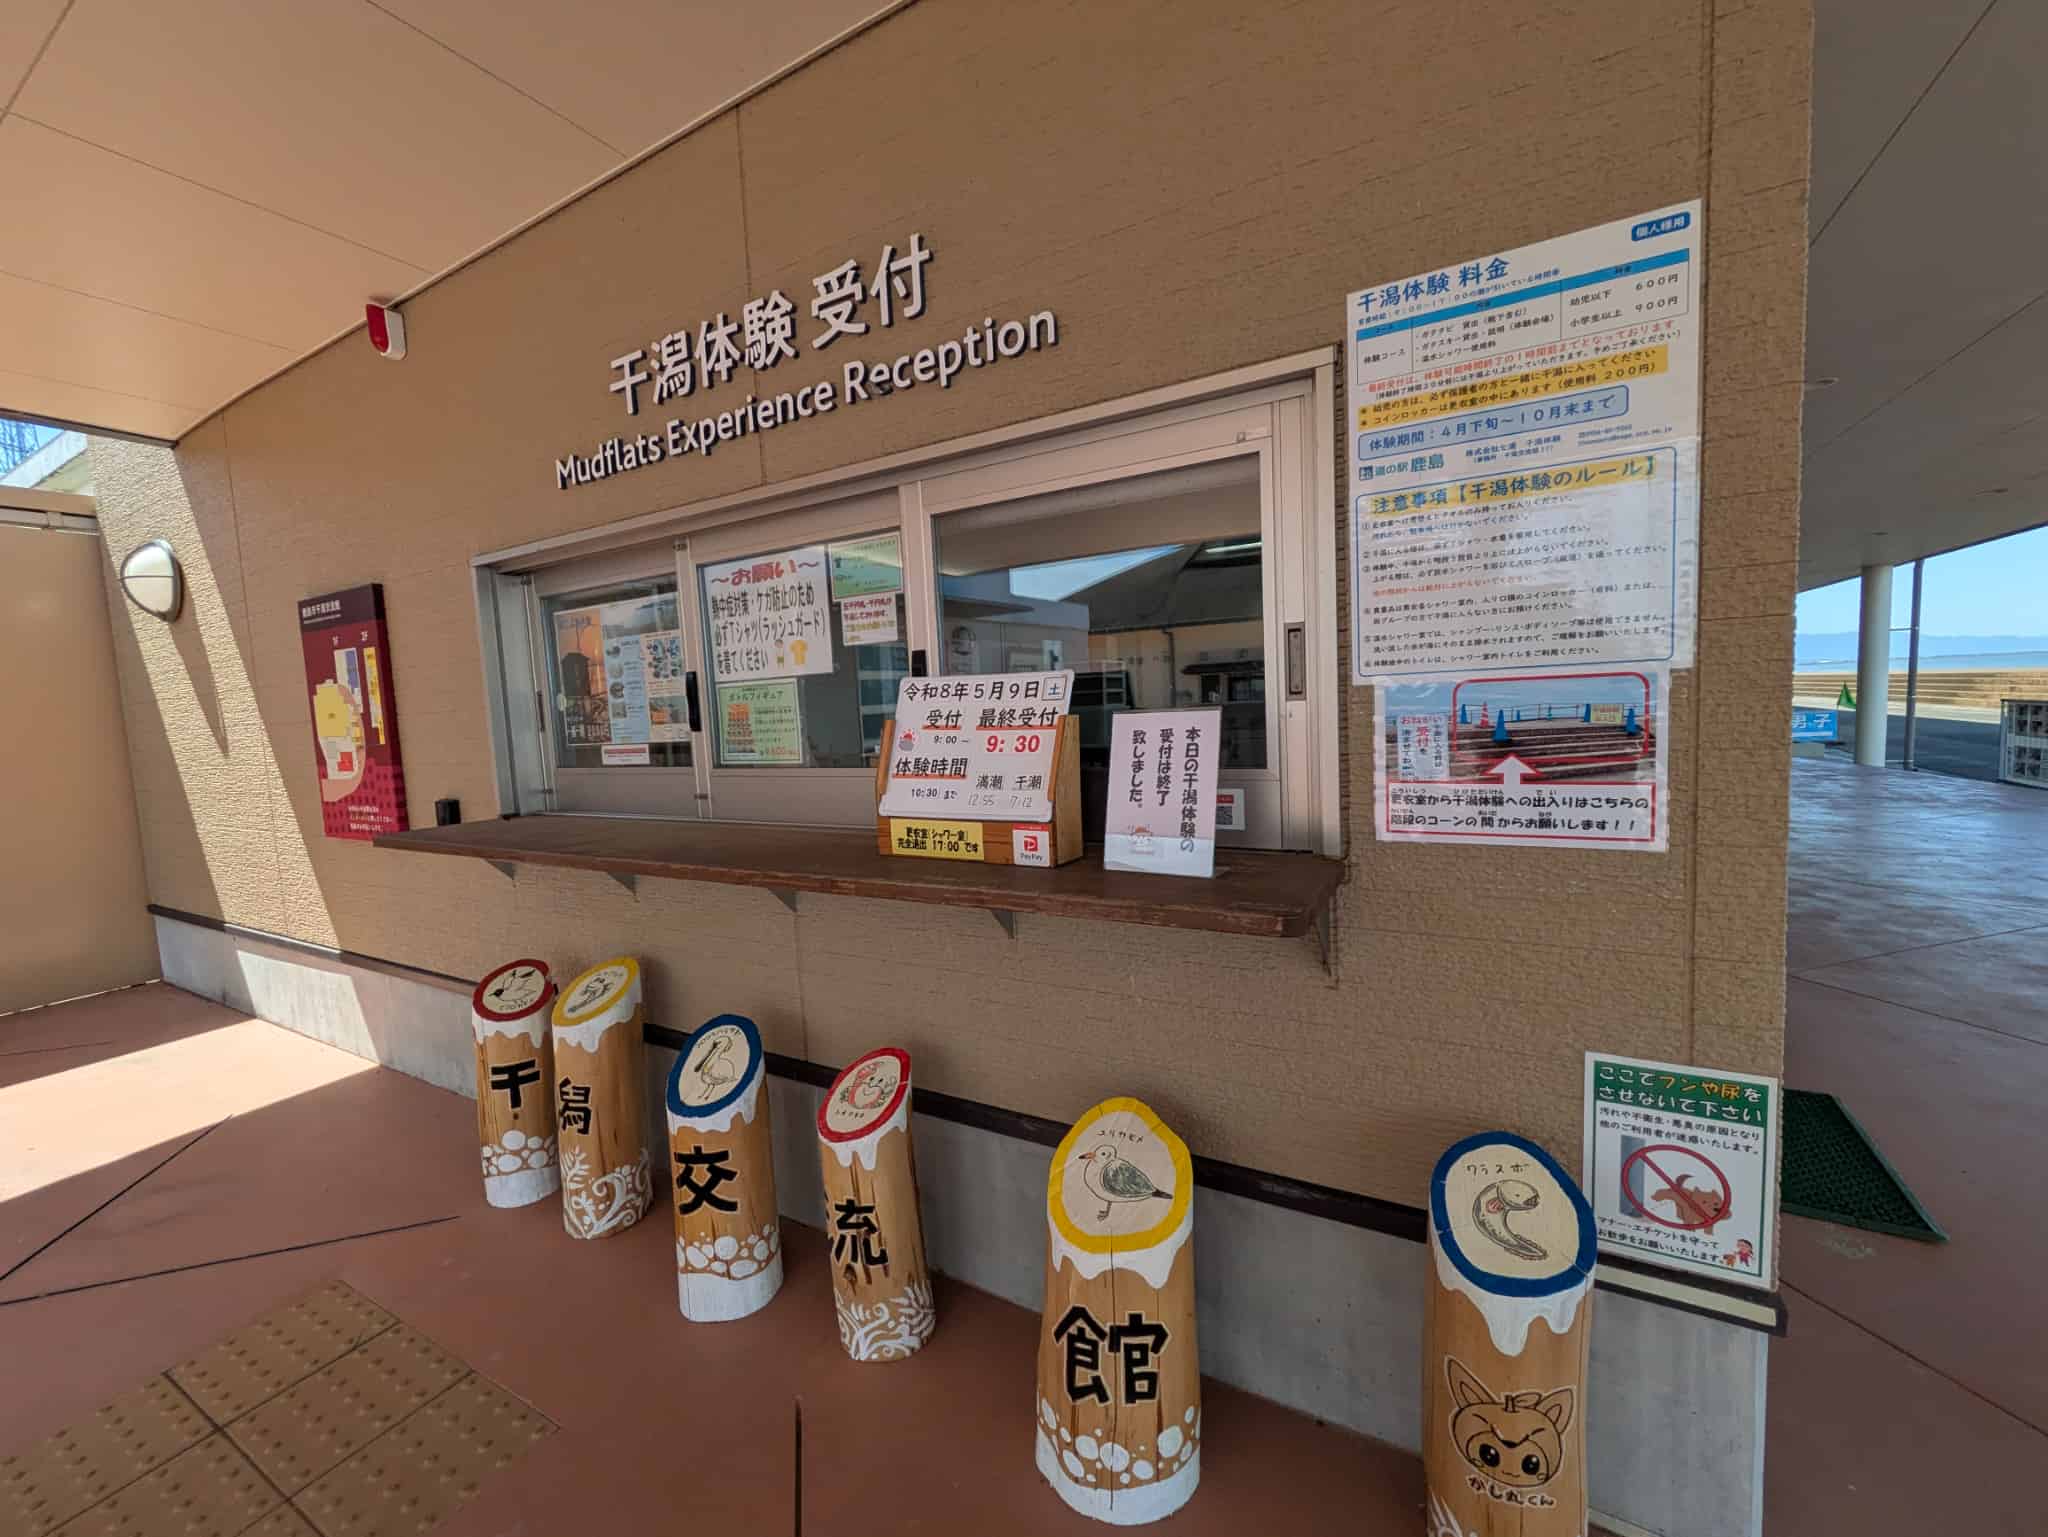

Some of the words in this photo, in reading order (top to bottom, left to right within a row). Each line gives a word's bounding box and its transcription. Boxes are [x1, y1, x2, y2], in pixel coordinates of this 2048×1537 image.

[1636, 215, 1685, 238] 個人様用
[1357, 272, 1451, 313] 干潟体験
[1458, 257, 1510, 287] 料金
[1635, 274, 1678, 290] 600円
[1635, 296, 1678, 312] 900円
[609, 289, 796, 414] 干潟体験
[810, 233, 930, 349] 受付
[555, 431, 662, 489] Mudflats
[667, 380, 833, 456] Experience
[844, 310, 1057, 403] Reception
[904, 680, 1040, 702] 令和8年5月9日
[1047, 682, 1061, 696] 土
[926, 709, 962, 729] 受付
[979, 706, 1058, 728] 最終受付
[986, 734, 1041, 753] 9:30
[895, 757, 968, 778] 体験時間
[976, 775, 1003, 790] 満潮
[1016, 775, 1042, 790] 干潮
[1129, 729, 1148, 808] 致しました。
[1156, 728, 1175, 806] 受付は終了
[911, 788, 938, 799] 10:30
[1180, 726, 1201, 853] 本日の干潟体験の
[932, 839, 960, 852] 17:00
[1599, 1066, 1762, 1102] ここでフンや尿を
[1599, 1086, 1762, 1121] させないで下さい
[674, 1145, 738, 1215] 交
[1466, 1163, 1529, 1175] ワラスボ
[1054, 1306, 1169, 1404] 館
